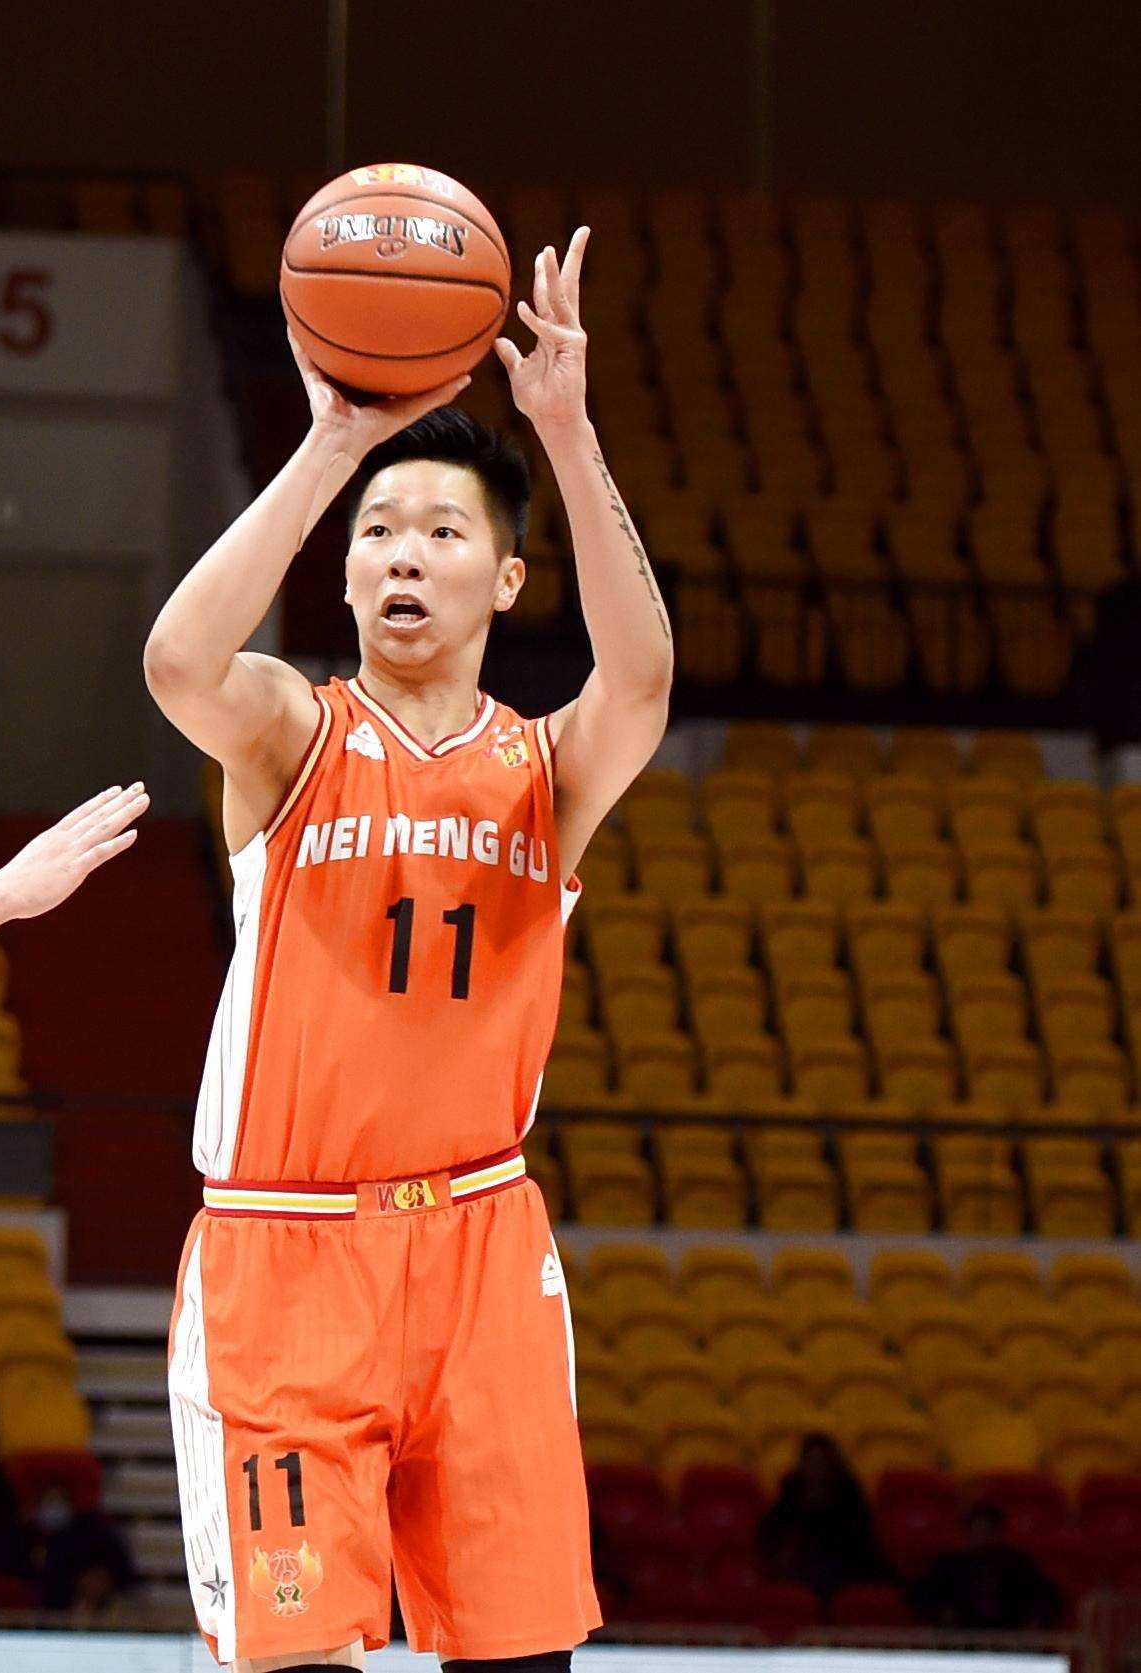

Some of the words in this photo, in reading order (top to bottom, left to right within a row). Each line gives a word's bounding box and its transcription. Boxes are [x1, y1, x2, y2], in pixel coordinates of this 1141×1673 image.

[316, 214, 470, 258] SPALDING
[295, 815, 372, 869] NEI
[382, 812, 500, 865] MENG
[509, 831, 548, 883] GU
[386, 897, 477, 1000] 11
[242, 1451, 306, 1531] 11
